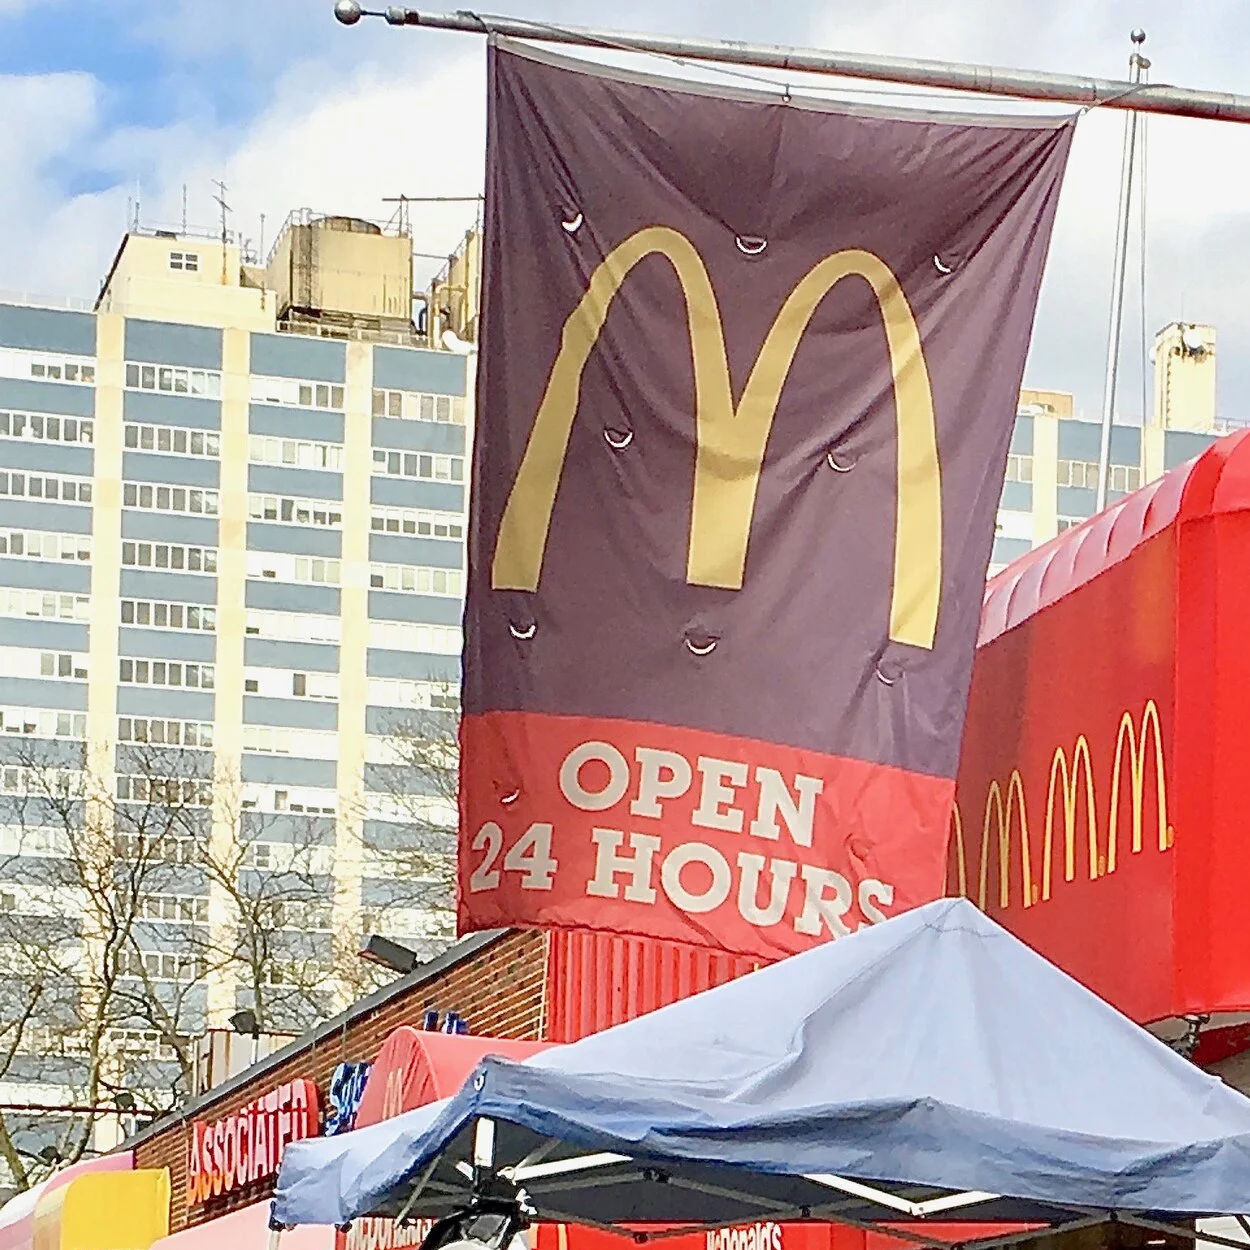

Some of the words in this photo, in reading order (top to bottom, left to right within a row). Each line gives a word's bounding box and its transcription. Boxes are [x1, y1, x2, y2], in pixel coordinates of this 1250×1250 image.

[559, 740, 824, 849] OPEN
[469, 821, 558, 893] 24
[586, 826, 893, 938] HOURS
